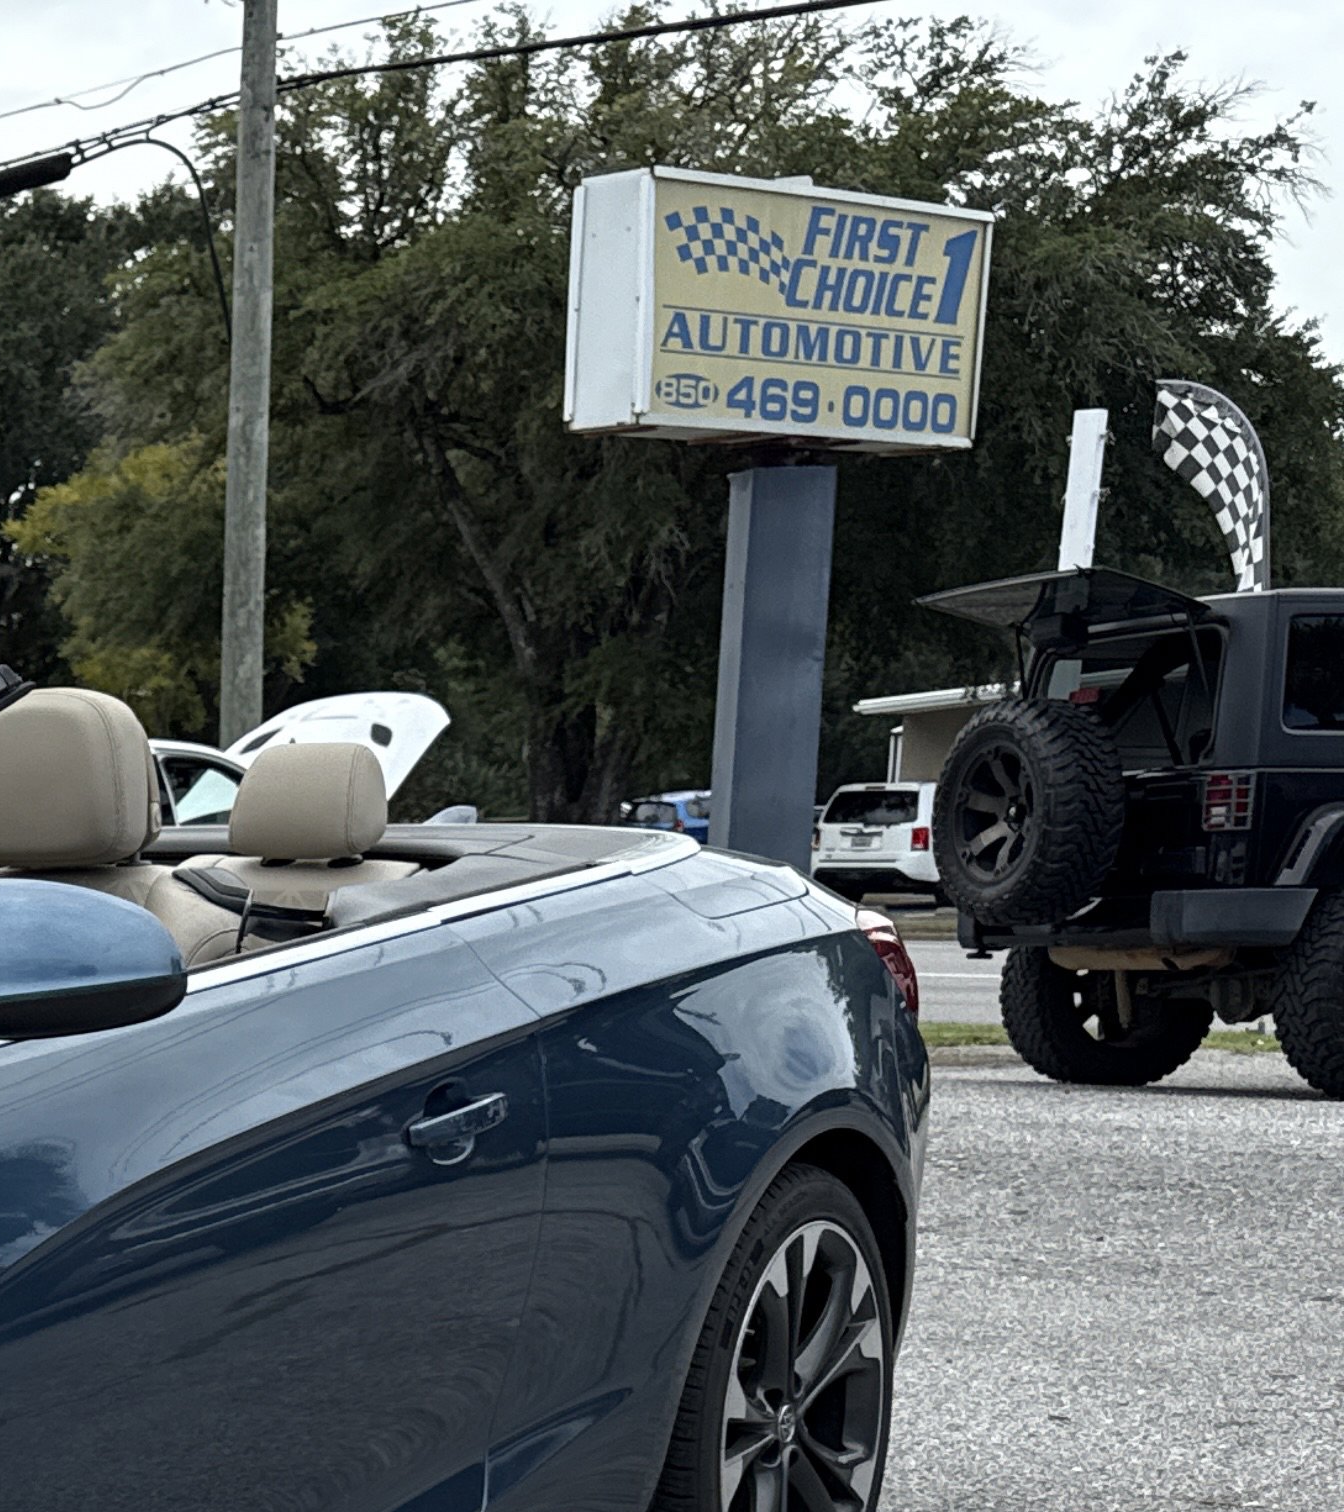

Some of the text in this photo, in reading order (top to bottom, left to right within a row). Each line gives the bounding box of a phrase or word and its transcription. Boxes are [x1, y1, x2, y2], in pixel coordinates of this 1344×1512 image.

[801, 205, 930, 268] FIRST
[785, 229, 978, 325] CHOICE 1
[660, 311, 964, 375] AUTOMOTIVE
[659, 378, 713, 406] 850
